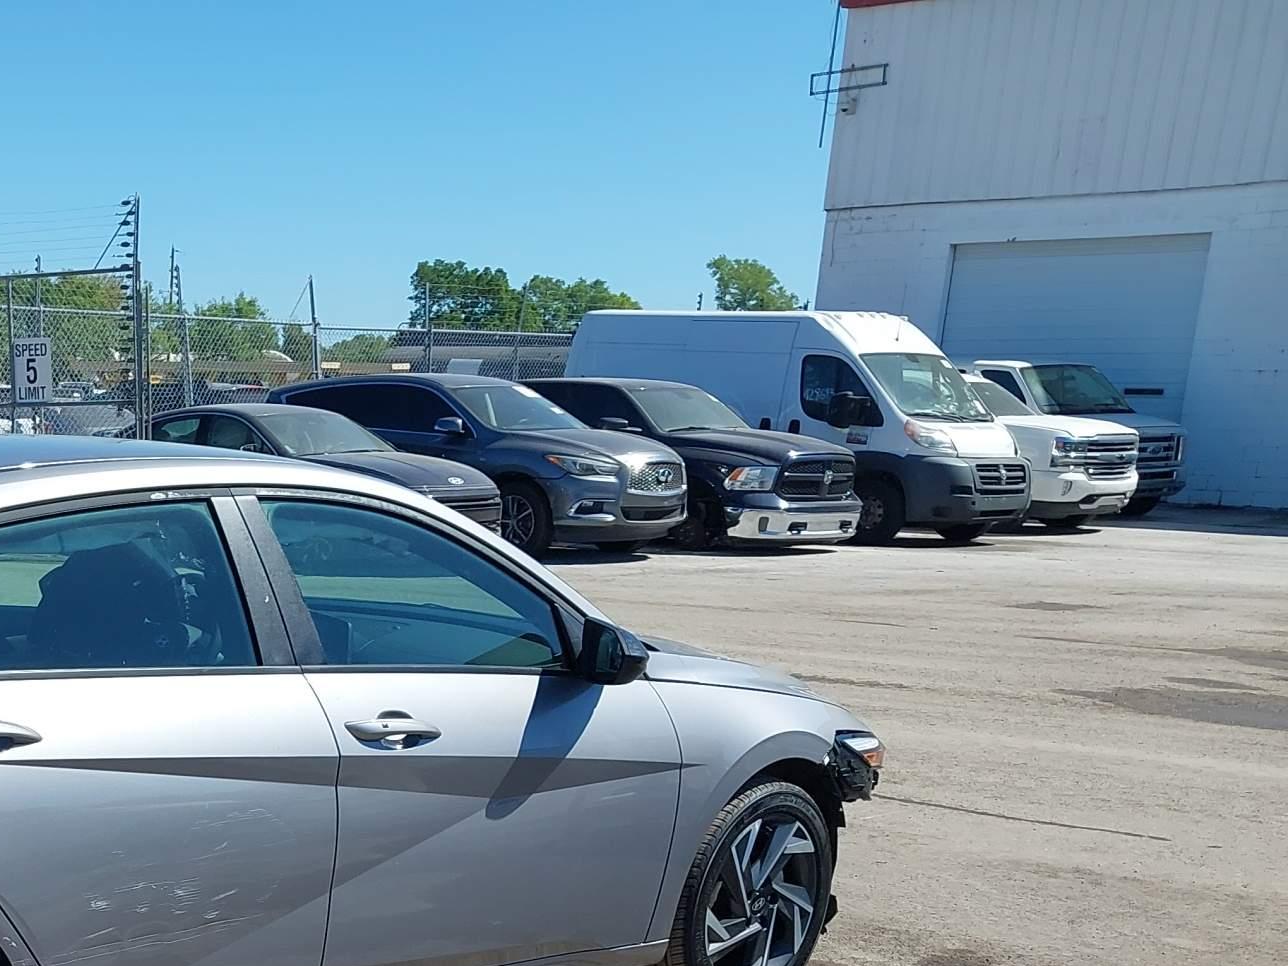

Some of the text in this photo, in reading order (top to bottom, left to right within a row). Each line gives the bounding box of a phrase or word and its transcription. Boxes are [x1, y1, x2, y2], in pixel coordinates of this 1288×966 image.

[15, 343, 47, 357] SPEED
[26, 358, 37, 384] 5
[18, 386, 47, 400] LIMIT
